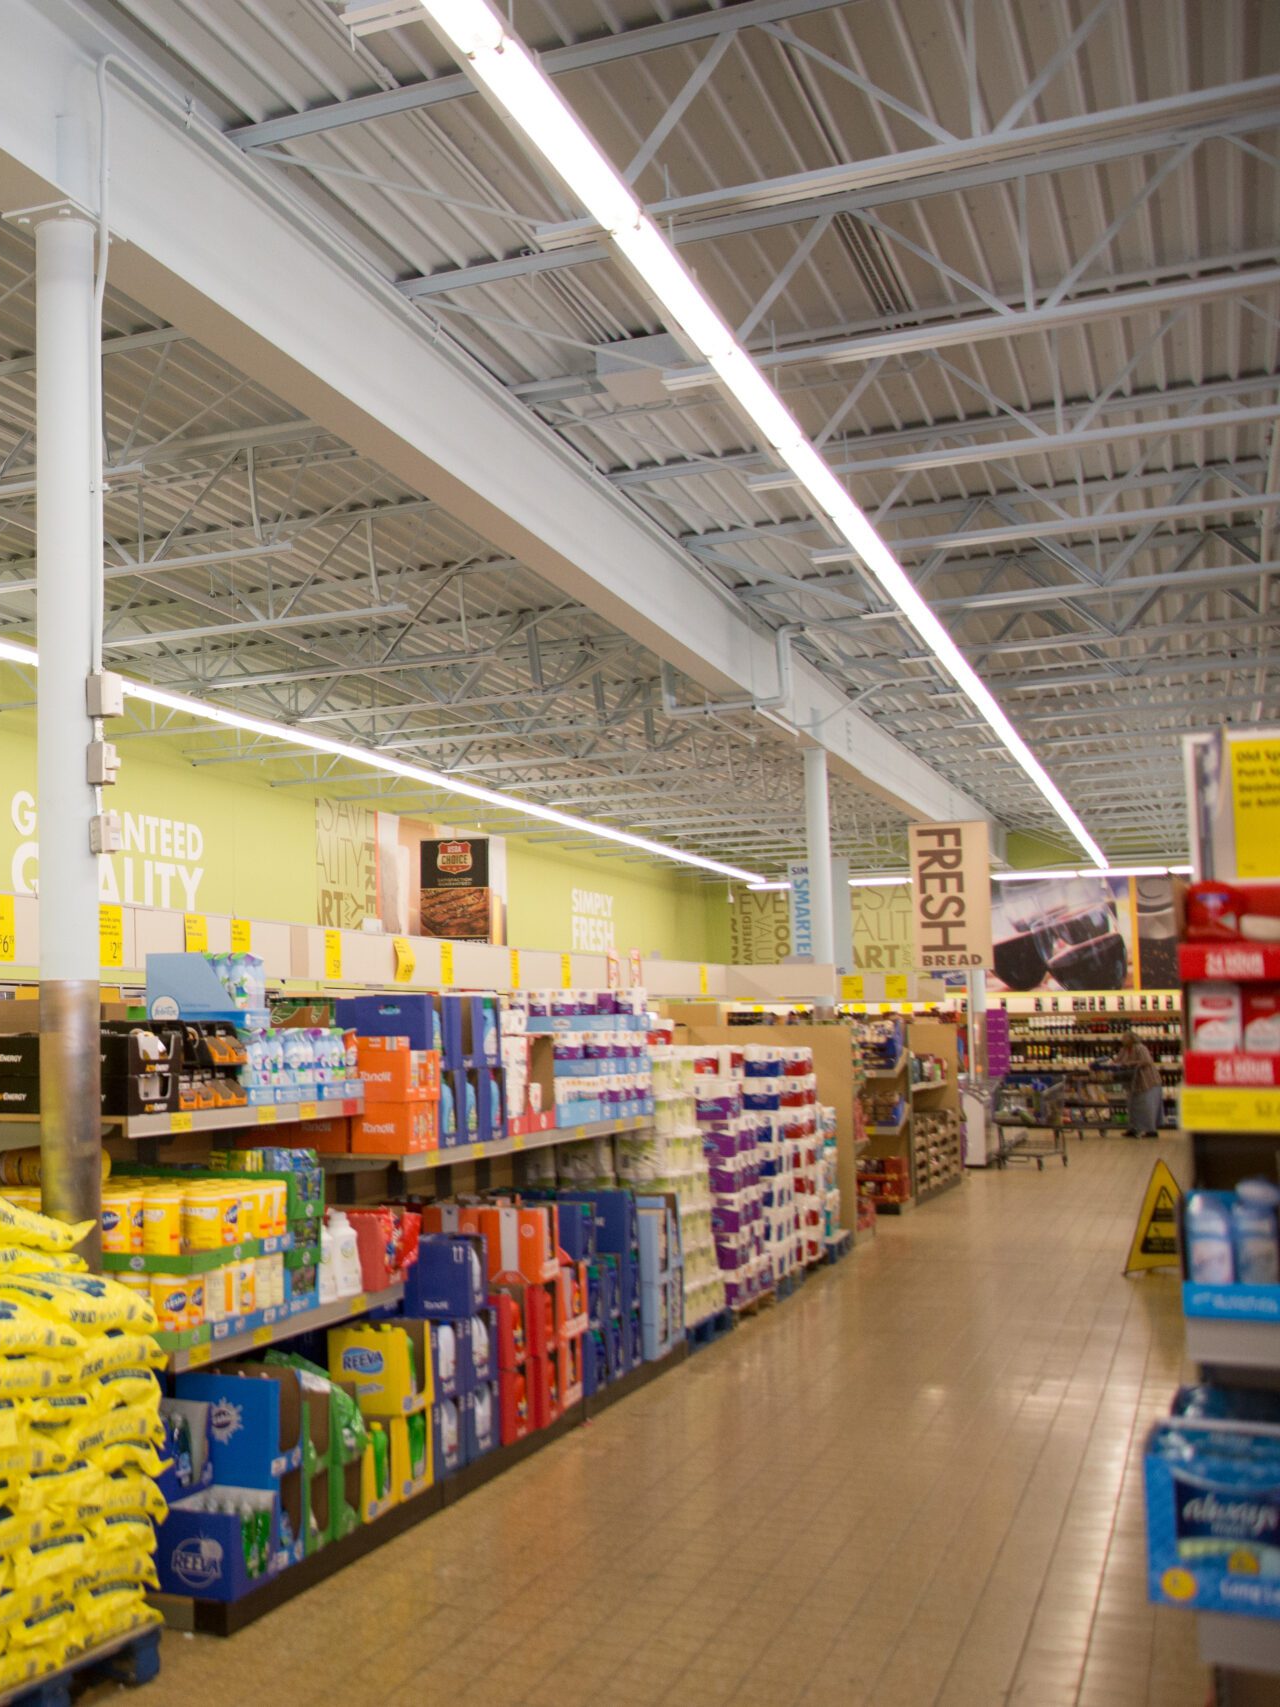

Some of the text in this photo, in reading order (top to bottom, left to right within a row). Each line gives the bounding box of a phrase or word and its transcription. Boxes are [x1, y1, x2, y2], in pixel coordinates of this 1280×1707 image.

[11, 790, 203, 861] GNTEED
[11, 841, 204, 912] QALITY
[441, 854, 468, 864] CHOICE
[571, 887, 614, 918] SIMPLY
[916, 828, 968, 953] FRESH
[571, 914, 615, 953] FRESH
[793, 879, 812, 957] SMARTE
[922, 954, 983, 967] BREAD
[362, 1122, 395, 1134] Tandil
[343, 1350, 384, 1371] REEVA
